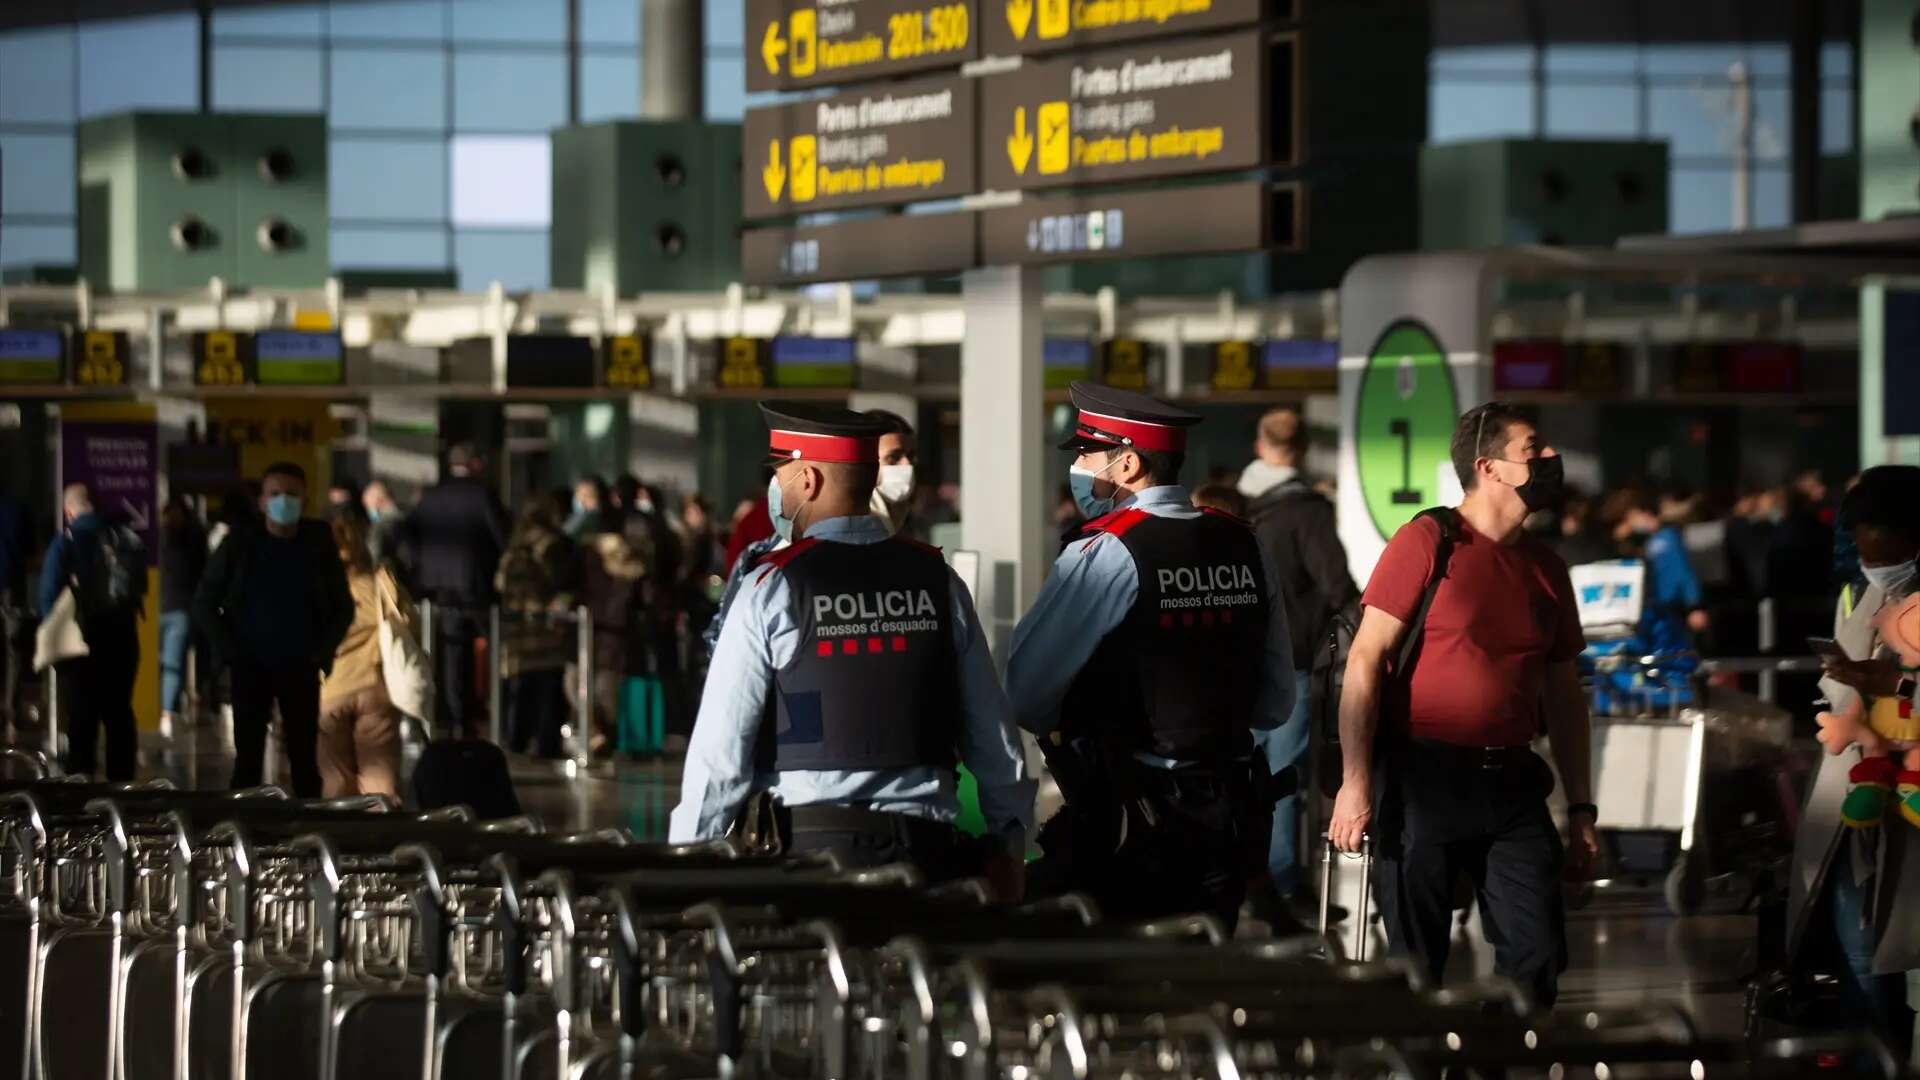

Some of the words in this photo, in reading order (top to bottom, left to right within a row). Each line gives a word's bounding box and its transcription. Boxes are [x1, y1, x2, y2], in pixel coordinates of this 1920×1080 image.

[1071, 66, 1118, 98] Portes
[817, 102, 857, 133] Portes
[1072, 135, 1126, 168] Puertas
[1129, 128, 1147, 161] de
[1150, 125, 1224, 160] embarque
[818, 165, 864, 195] Puertas
[883, 158, 945, 188] embarque
[1157, 565, 1256, 593] POLICIA
[813, 589, 936, 622] POLICIA
[1161, 596, 1202, 609] mossos
[1203, 592, 1258, 607] d'esquadra
[816, 623, 868, 637] mossos
[870, 618, 938, 634] d'esquadra
